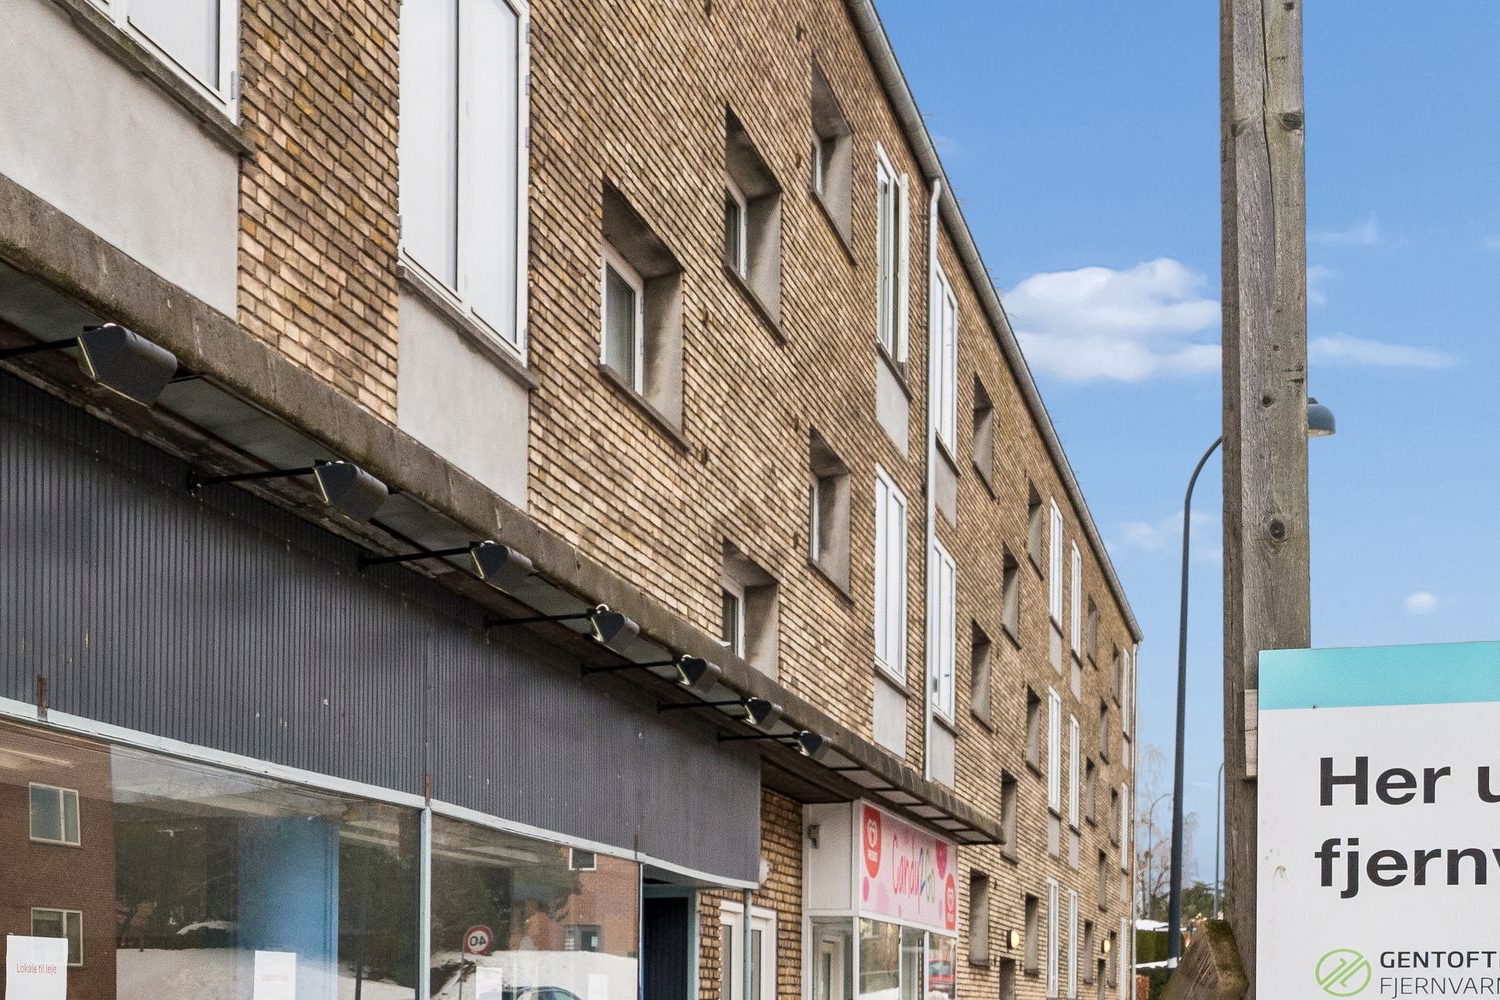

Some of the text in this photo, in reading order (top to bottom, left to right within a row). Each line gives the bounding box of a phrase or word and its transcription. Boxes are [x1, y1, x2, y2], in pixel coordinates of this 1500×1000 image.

[1320, 756, 1451, 806] Her
[1315, 837, 1500, 899] fjern
[1380, 951, 1500, 968] GENTOFT
[1380, 977, 1500, 999] FJERNVAR
